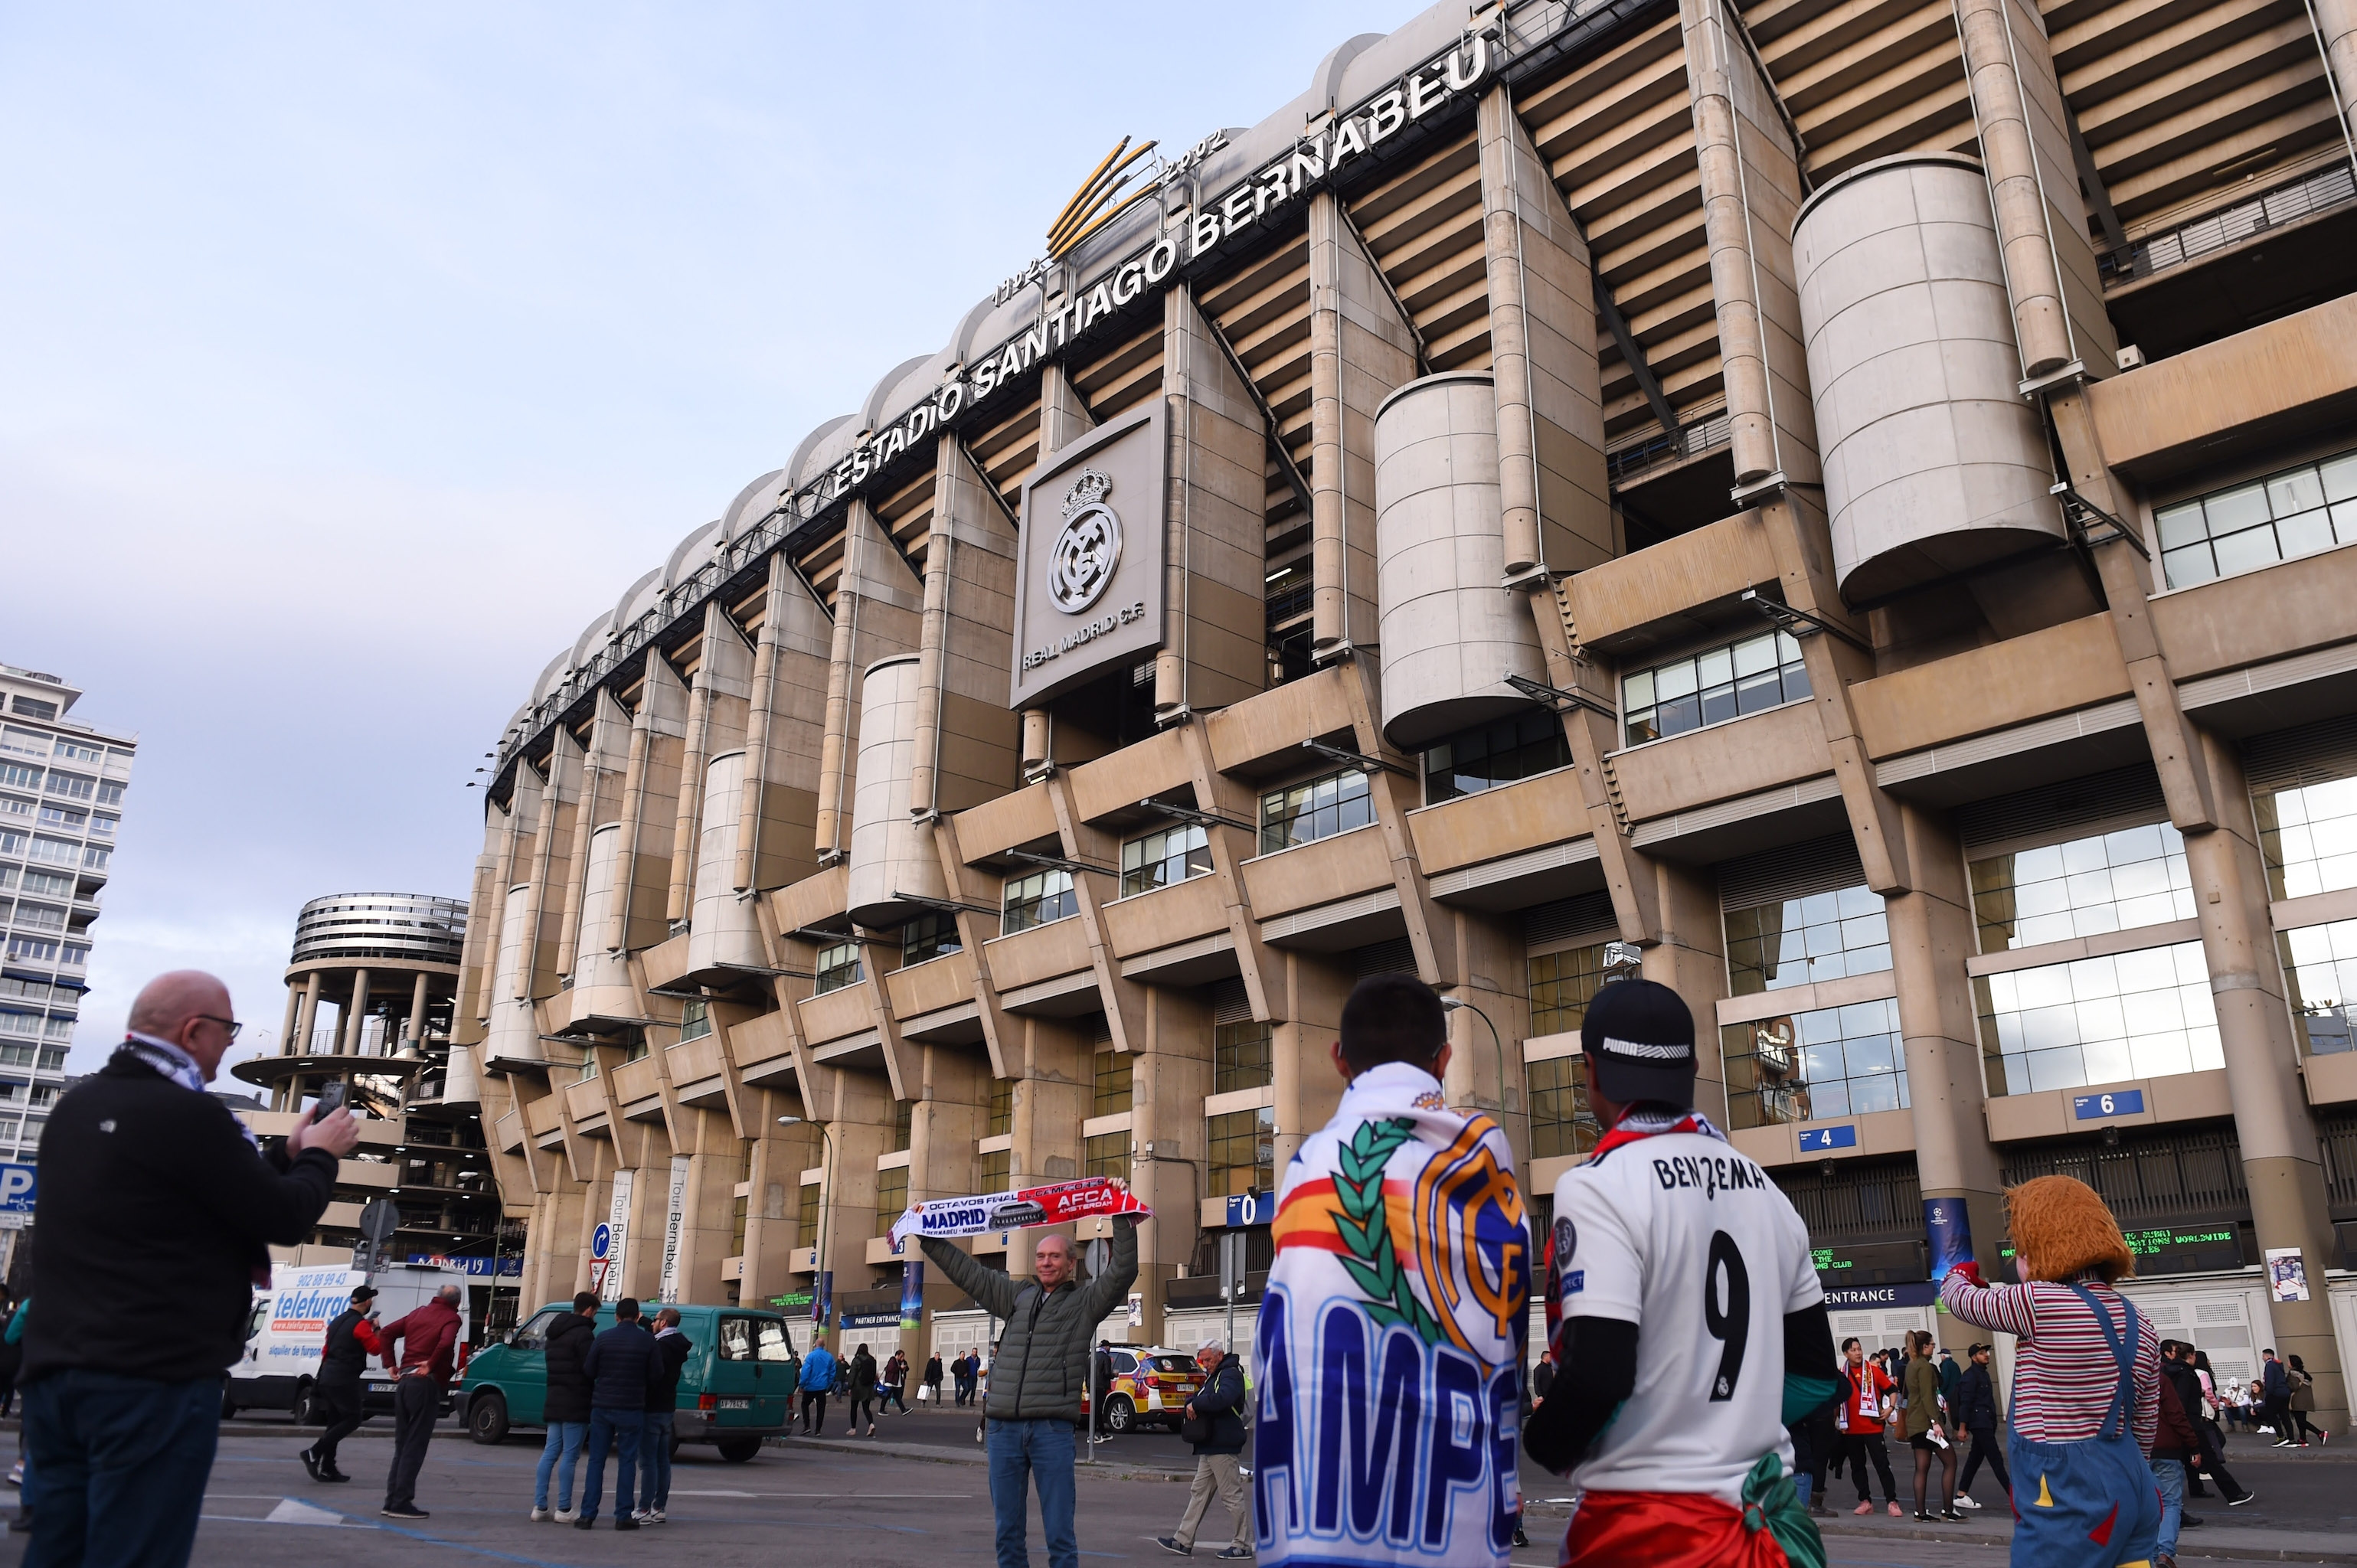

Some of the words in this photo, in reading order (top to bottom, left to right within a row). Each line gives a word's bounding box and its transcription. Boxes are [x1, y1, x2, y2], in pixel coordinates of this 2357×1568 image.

[1166, 127, 1230, 183] 2002
[833, 381, 966, 499] ESTADIO
[974, 238, 1180, 399] SANTIAGO
[1190, 35, 1490, 259] BERNABEU
[1023, 644, 1058, 670] REAL
[1060, 615, 1116, 654] MADRID
[1603, 1037, 1638, 1057] PUMA
[2100, 1094, 2114, 1114] 6
[1821, 1129, 1832, 1146] 4
[0, 1168, 34, 1206] P
[1653, 1156, 1767, 1201] BENZEMA
[671, 1180, 685, 1210] Tour
[929, 1198, 984, 1210] OCTAVOS
[986, 1194, 1018, 1204] FINAL
[1058, 1188, 1113, 1208] AFCA
[613, 1193, 627, 1220] Tour
[1059, 1200, 1113, 1214] AMSTERDAM
[1241, 1194, 1257, 1225] 0
[922, 1208, 986, 1229] MADRID
[664, 1213, 682, 1279] Bernabéu
[898, 1242, 904, 1253] 3
[2175, 1232, 2231, 1244] WORLDWIDE
[607, 1223, 624, 1286] Bernabéu
[1809, 1249, 1834, 1257] LCOME
[472, 1259, 483, 1274] 19
[296, 1274, 313, 1287] 902
[312, 1273, 323, 1286] 88
[323, 1273, 335, 1285] 99
[335, 1272, 347, 1285] 43
[1824, 1289, 1895, 1304] ENTRANCE
[855, 1316, 876, 1325] PARTNER
[876, 1314, 901, 1324] ENTRANCE
[1705, 1230, 1751, 1403] 9
[269, 1344, 291, 1357] alquiler
[292, 1345, 299, 1356] de
[300, 1345, 322, 1358] furgon
